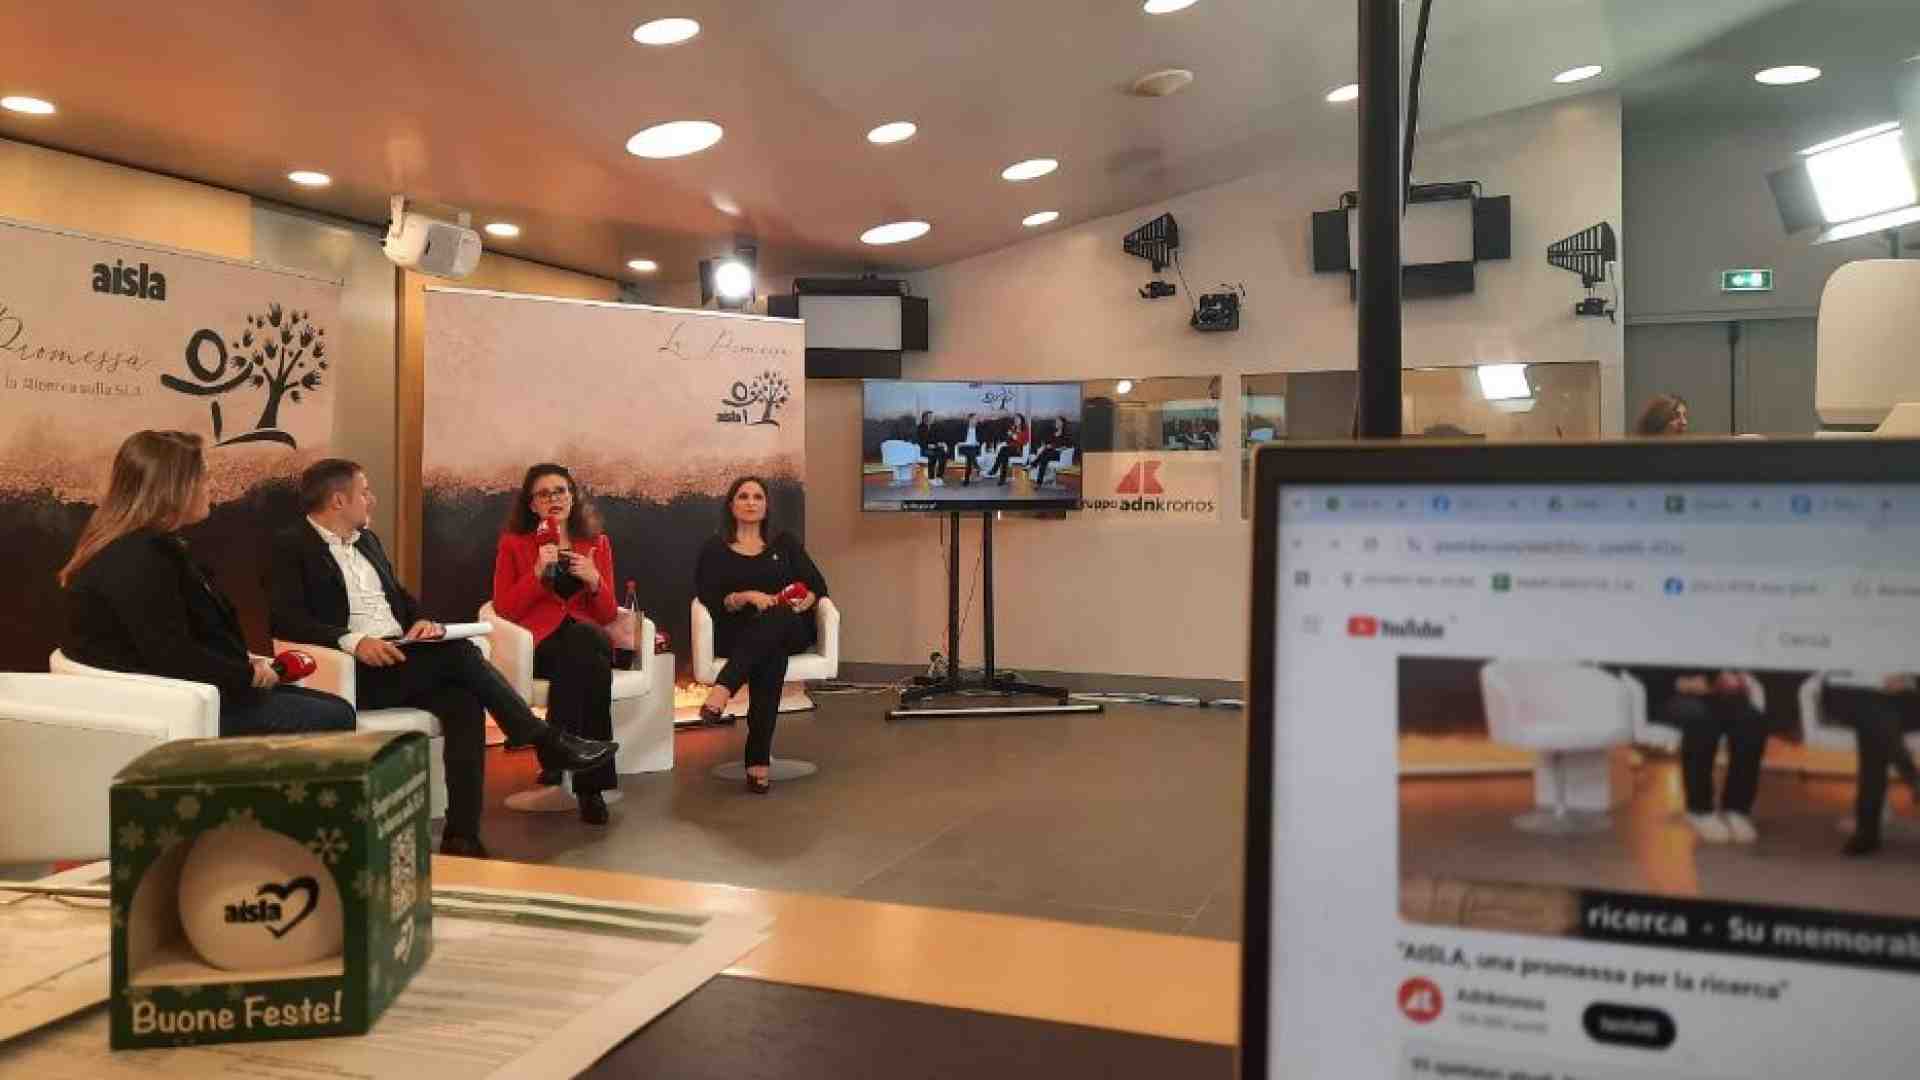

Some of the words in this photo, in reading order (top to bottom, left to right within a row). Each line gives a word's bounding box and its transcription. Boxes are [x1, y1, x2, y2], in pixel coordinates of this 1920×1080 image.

[92, 259, 166, 300] aisla
[1120, 496, 1216, 513] adnkronos
[1381, 618, 1445, 639] YouTube
[224, 898, 282, 924] aisla
[1587, 905, 1689, 936] ricerca
[1729, 915, 1765, 942] Su
[1477, 954, 1515, 971] una
[1521, 957, 1627, 984] promessa
[1632, 968, 1668, 990] per
[1674, 968, 1694, 990] la
[131, 1000, 235, 1035] Buone
[244, 989, 343, 1029] Feste!
